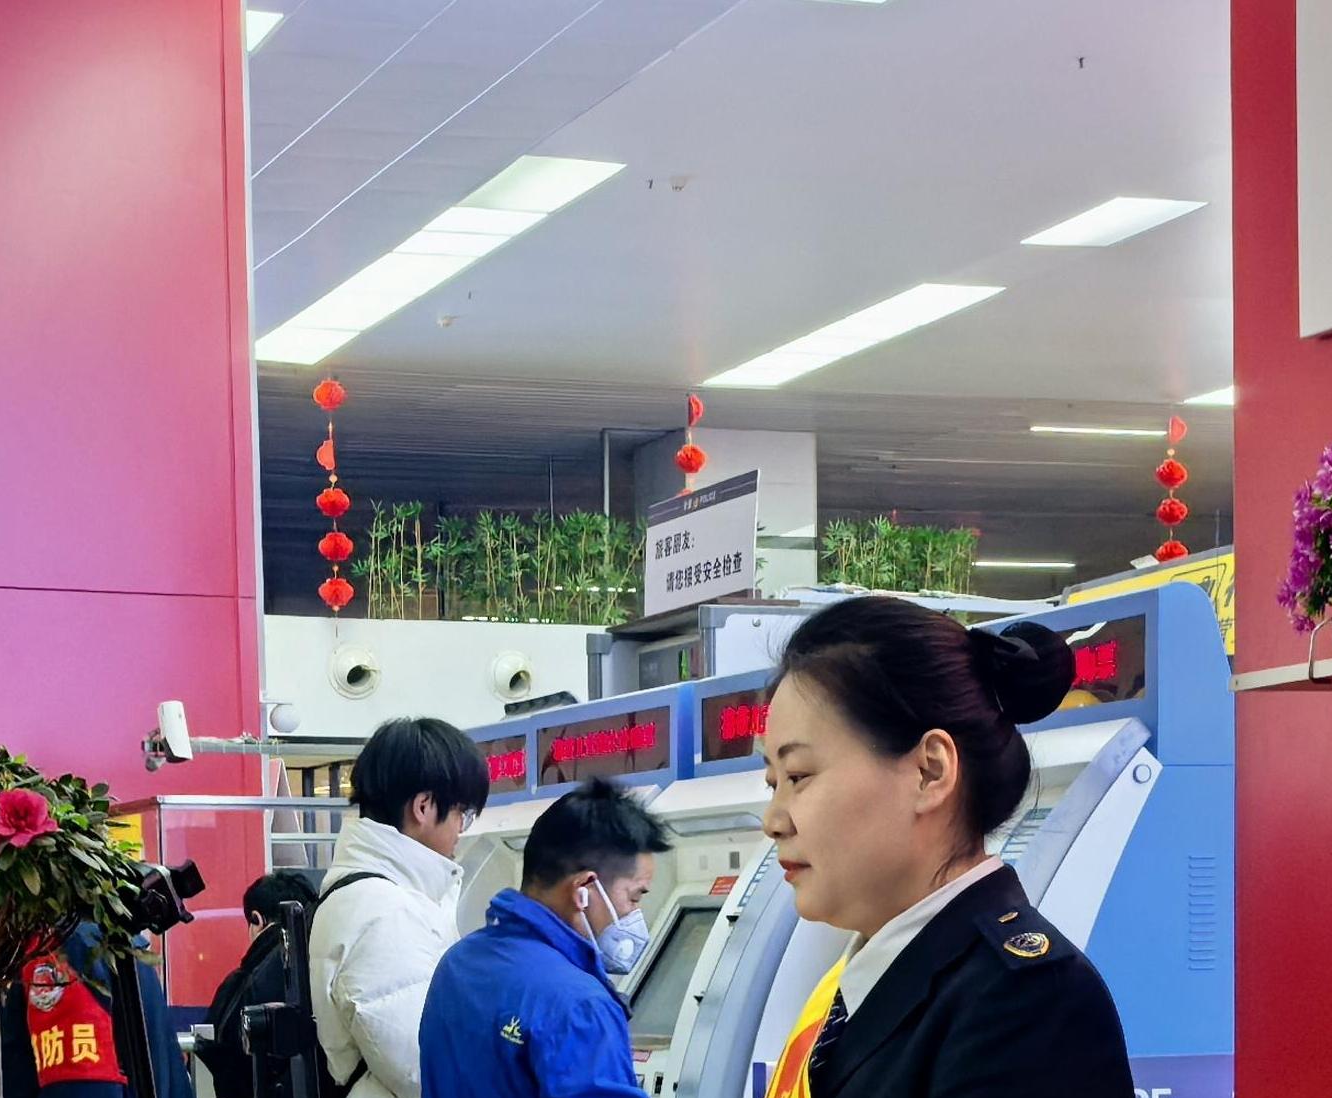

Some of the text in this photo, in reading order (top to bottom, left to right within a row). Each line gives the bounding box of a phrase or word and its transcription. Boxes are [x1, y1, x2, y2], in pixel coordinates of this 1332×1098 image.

[666, 550, 742, 593] 请您接受安全检查
[31, 1023, 101, 1073] 防员
